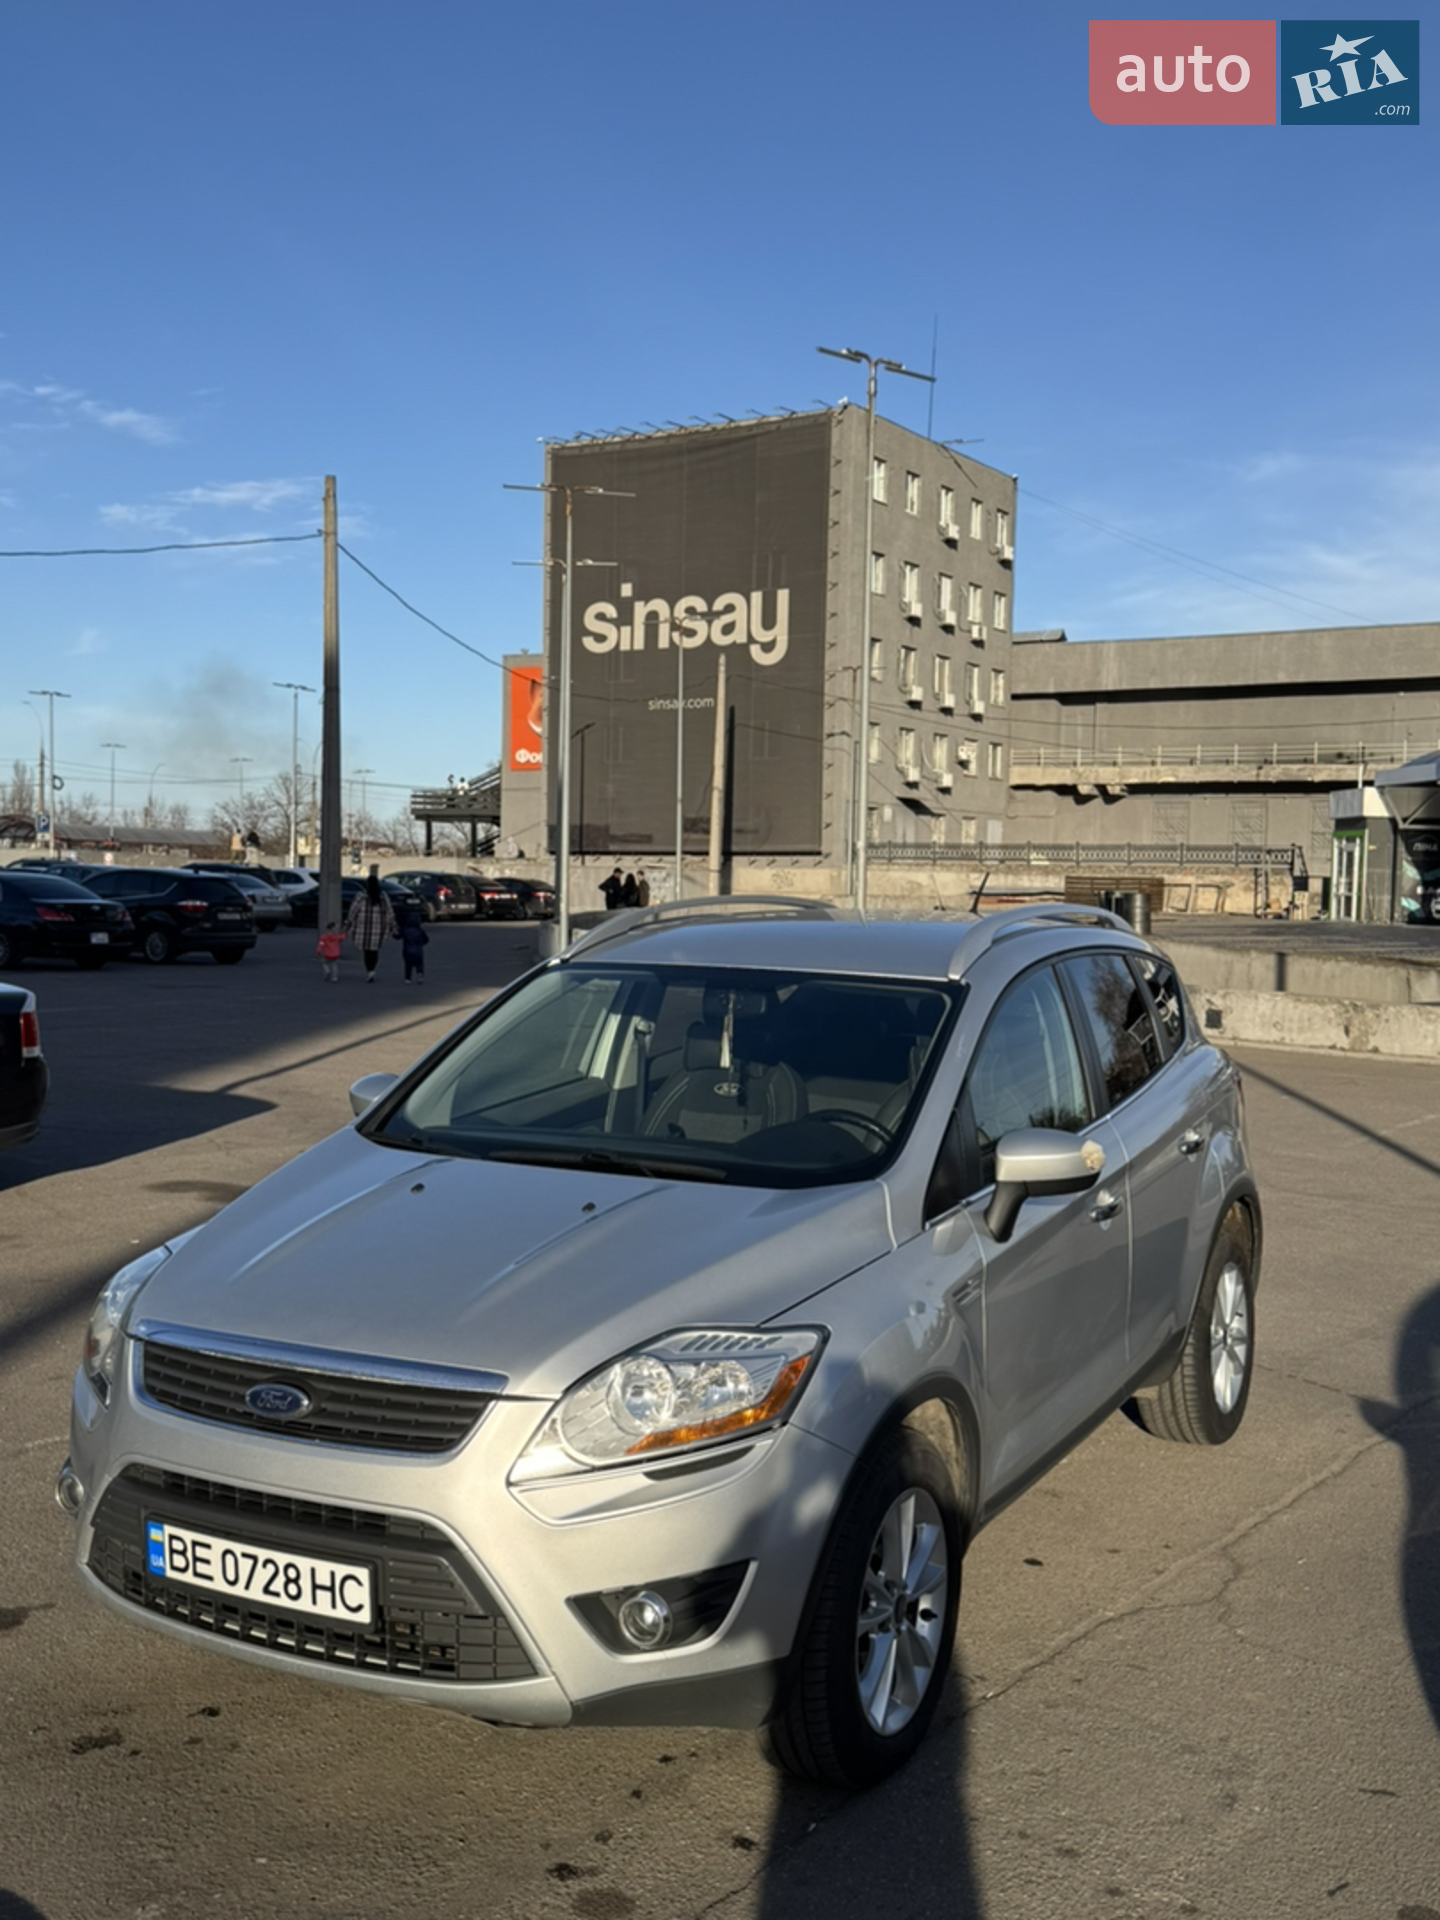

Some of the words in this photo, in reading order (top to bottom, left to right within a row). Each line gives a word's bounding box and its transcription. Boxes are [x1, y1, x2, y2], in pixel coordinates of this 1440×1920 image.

[582, 582, 790, 666] sinsay
[257, 1390, 293, 1410] Ford
[168, 1534, 214, 1582] BE
[221, 1548, 302, 1601] 0728
[310, 1566, 364, 1613] HC
